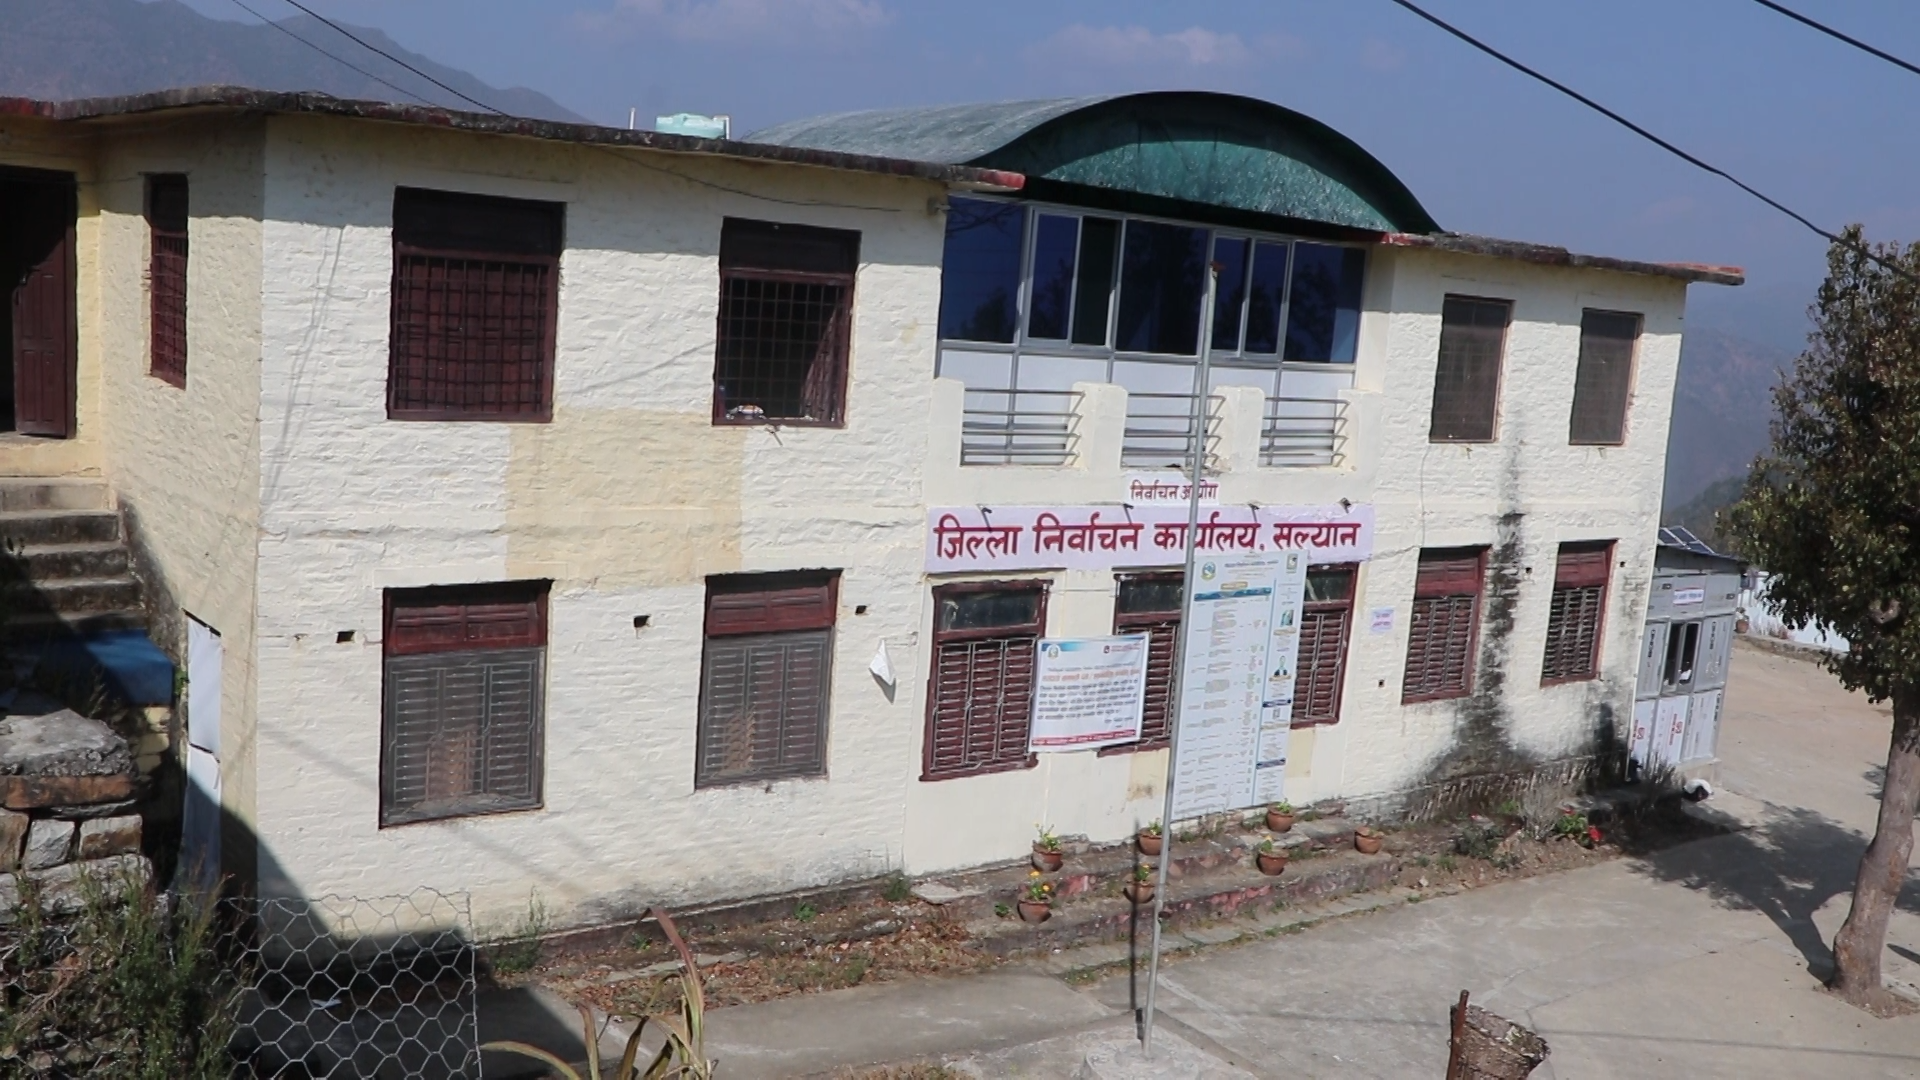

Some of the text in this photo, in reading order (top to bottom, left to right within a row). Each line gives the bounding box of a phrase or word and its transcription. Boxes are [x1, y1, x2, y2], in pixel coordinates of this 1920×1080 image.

[1130, 479, 1179, 500] निर्वाचन
[933, 513, 1023, 559] जिल्ला
[1032, 511, 1145, 554] निर्वाचन
[1273, 523, 1361, 549] सल्यान
